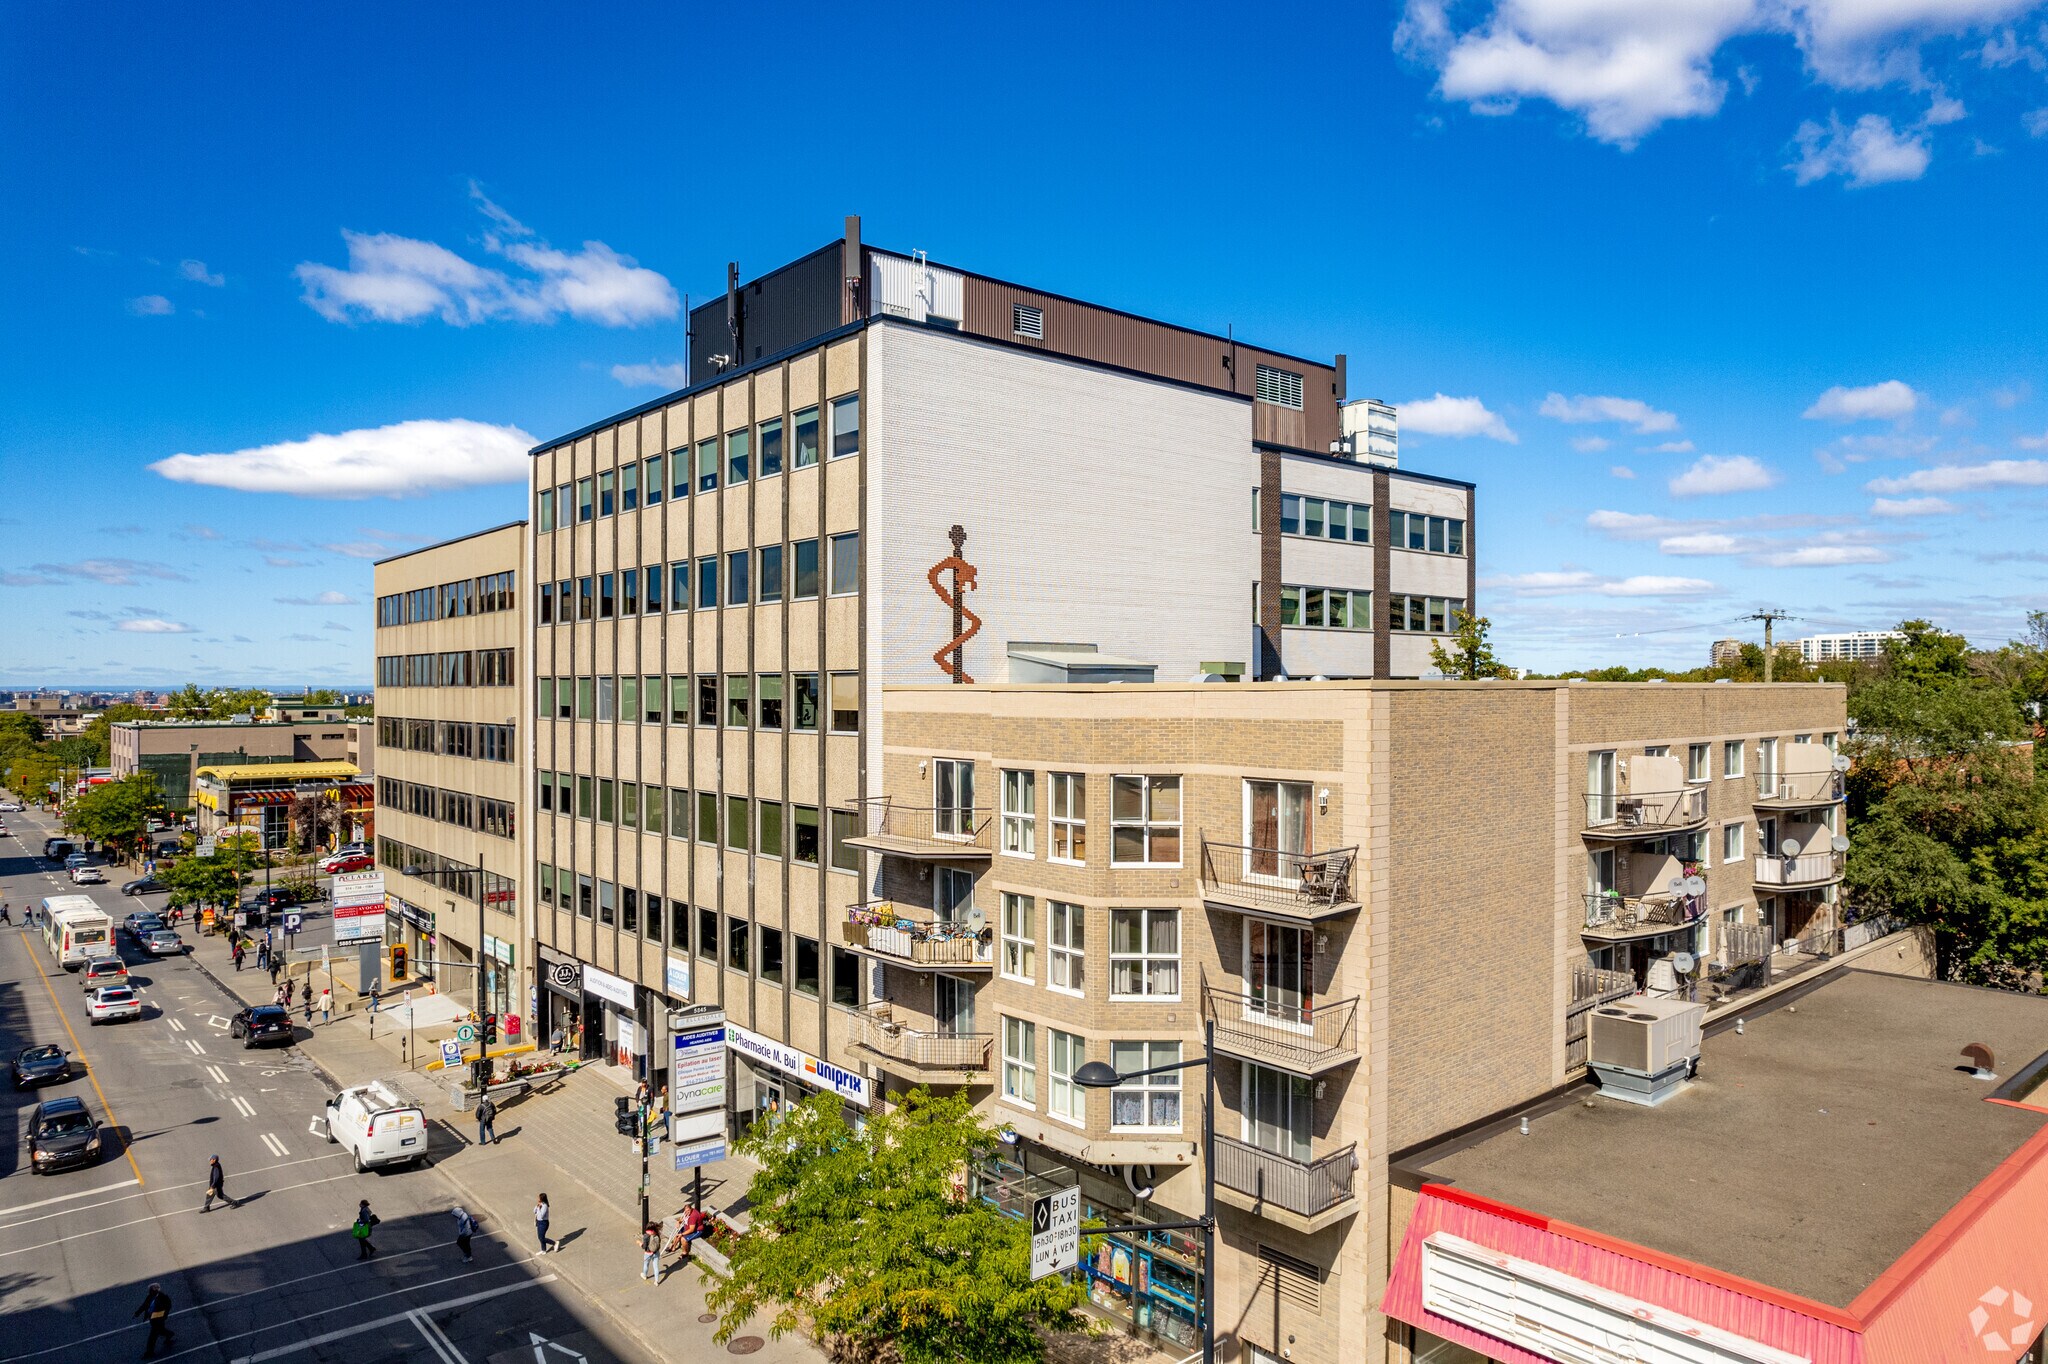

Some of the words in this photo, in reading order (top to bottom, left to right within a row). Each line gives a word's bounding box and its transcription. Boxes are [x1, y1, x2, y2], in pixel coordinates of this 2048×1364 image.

[345, 873, 378, 881] CLARKE
[287, 914, 300, 929] P
[682, 1033, 696, 1041] AIDES
[696, 1030, 719, 1039] AUDITIVES
[735, 1032, 771, 1059] Pharmacie
[772, 1048, 782, 1064] M.
[784, 1053, 796, 1070] Bui
[816, 1061, 862, 1093] uniprix
[677, 1084, 723, 1101] Dynacare
[681, 1153, 700, 1163] LOUER
[1052, 1194, 1077, 1212] BUS
[1052, 1209, 1077, 1228] TAXI
[1035, 1249, 1050, 1263] LUN
[1060, 1240, 1075, 1254] VEN
